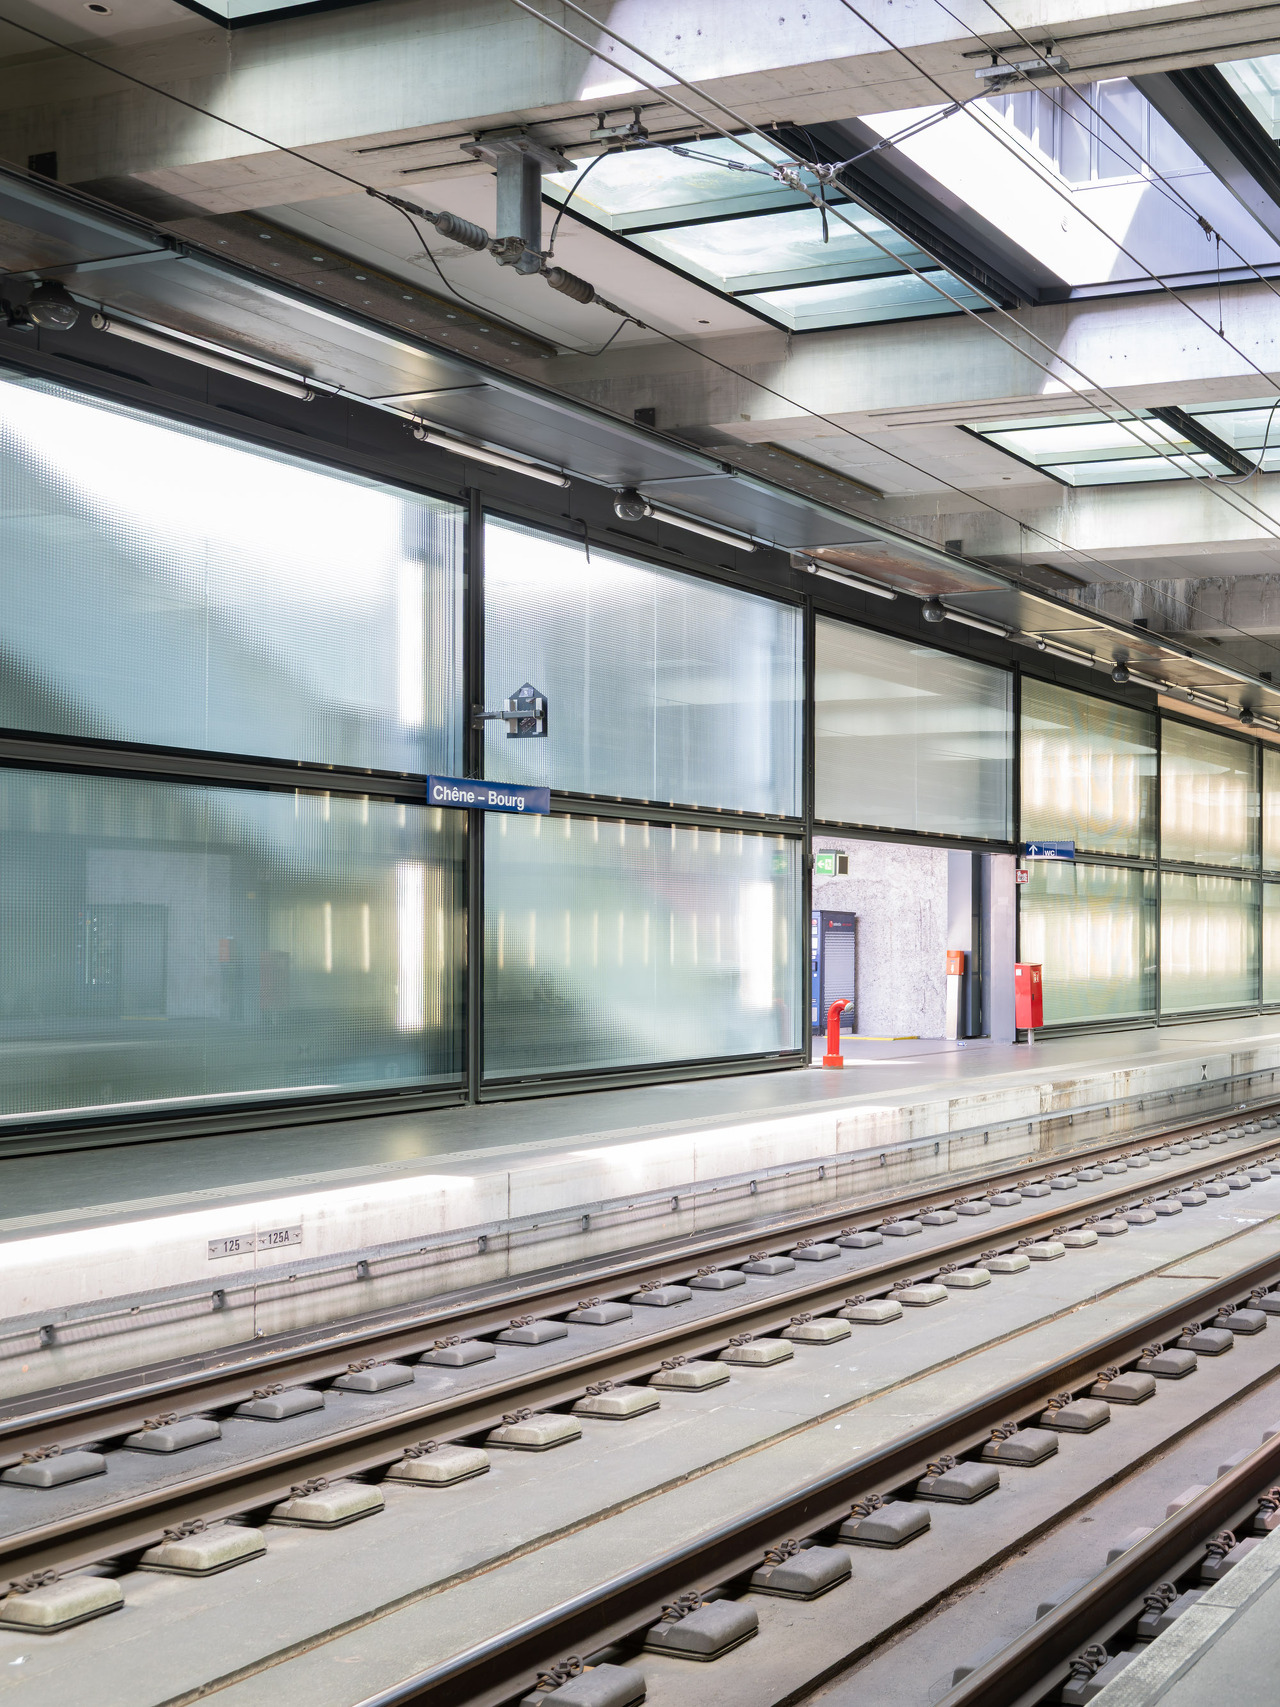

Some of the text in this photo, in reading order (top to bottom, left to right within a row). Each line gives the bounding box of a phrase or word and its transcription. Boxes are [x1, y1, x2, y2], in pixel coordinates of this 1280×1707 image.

[433, 785, 475, 803] Chêne
[488, 791, 525, 811] Bourg
[268, 1230, 290, 1244] 125A
[223, 1239, 240, 1253] 125
